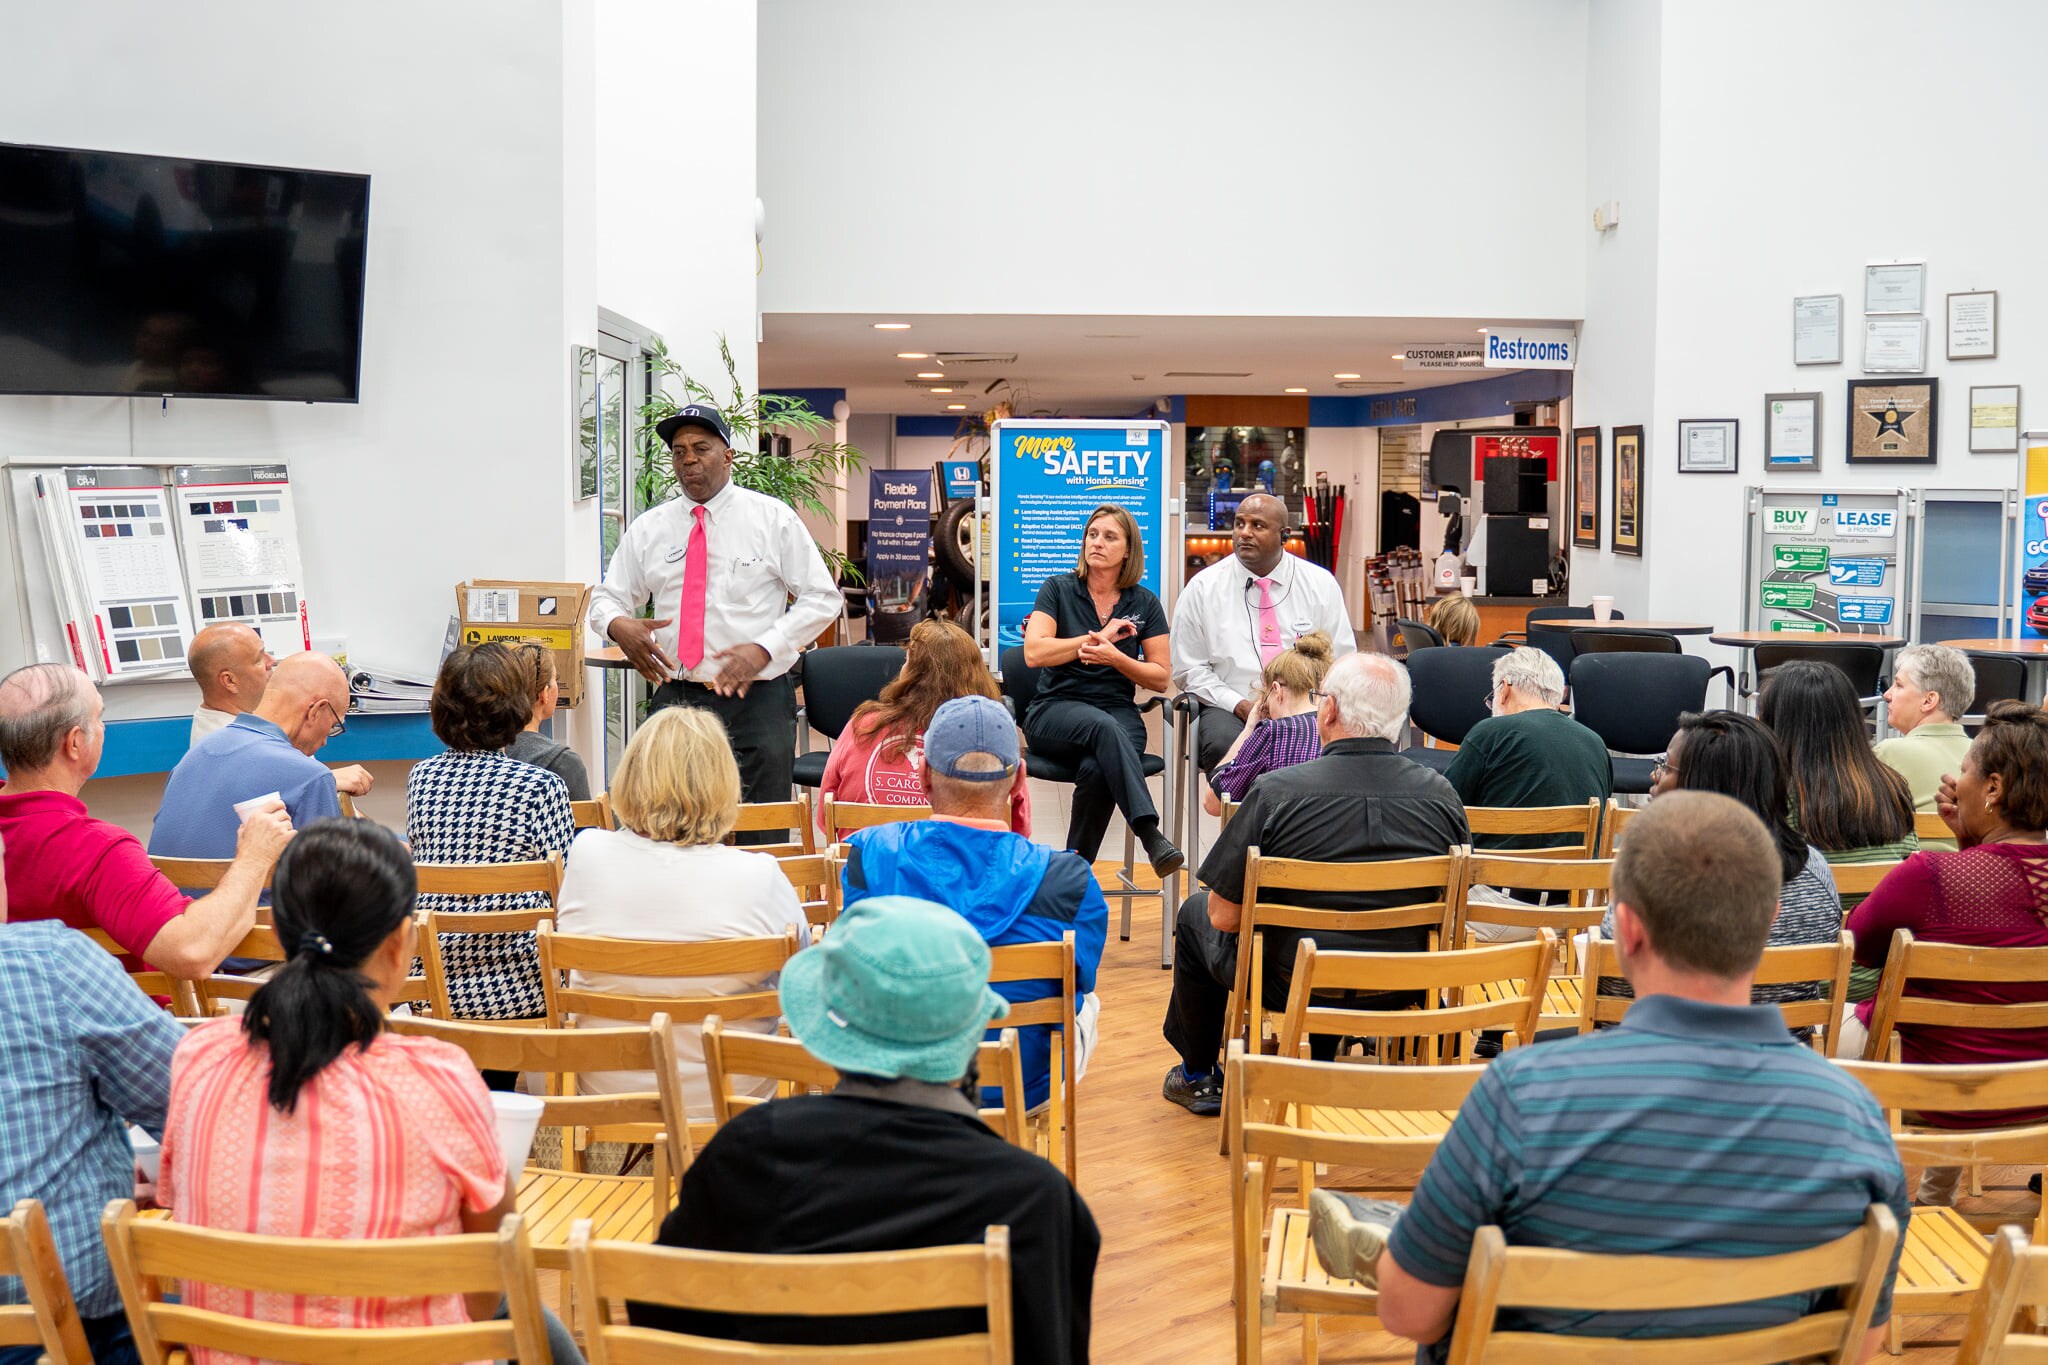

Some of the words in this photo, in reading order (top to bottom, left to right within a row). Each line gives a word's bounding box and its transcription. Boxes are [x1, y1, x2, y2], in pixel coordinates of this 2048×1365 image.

[1489, 335, 1568, 361] Restrooms
[1406, 350, 1454, 359] CUSTOMER
[1456, 350, 1484, 360] AMENI
[1014, 435, 1076, 459] More
[1043, 450, 1151, 476] SAFETY
[76, 477, 96, 486] CR-V
[253, 472, 288, 480] RIDGELINE
[1066, 476, 1084, 485] with
[1086, 476, 1112, 485] Honda
[884, 482, 918, 496] Flexible
[873, 498, 906, 512] Payment
[907, 499, 927, 511] Plans
[1774, 510, 1808, 523] BUY
[1820, 517, 1830, 525] or
[1837, 512, 1891, 526] LEASE
[876, 553, 890, 561] Apply
[487, 634, 521, 642] LAWSON
[875, 776, 884, 786] S.
[887, 777, 921, 790] CARO
[886, 794, 930, 805] COMPAN
